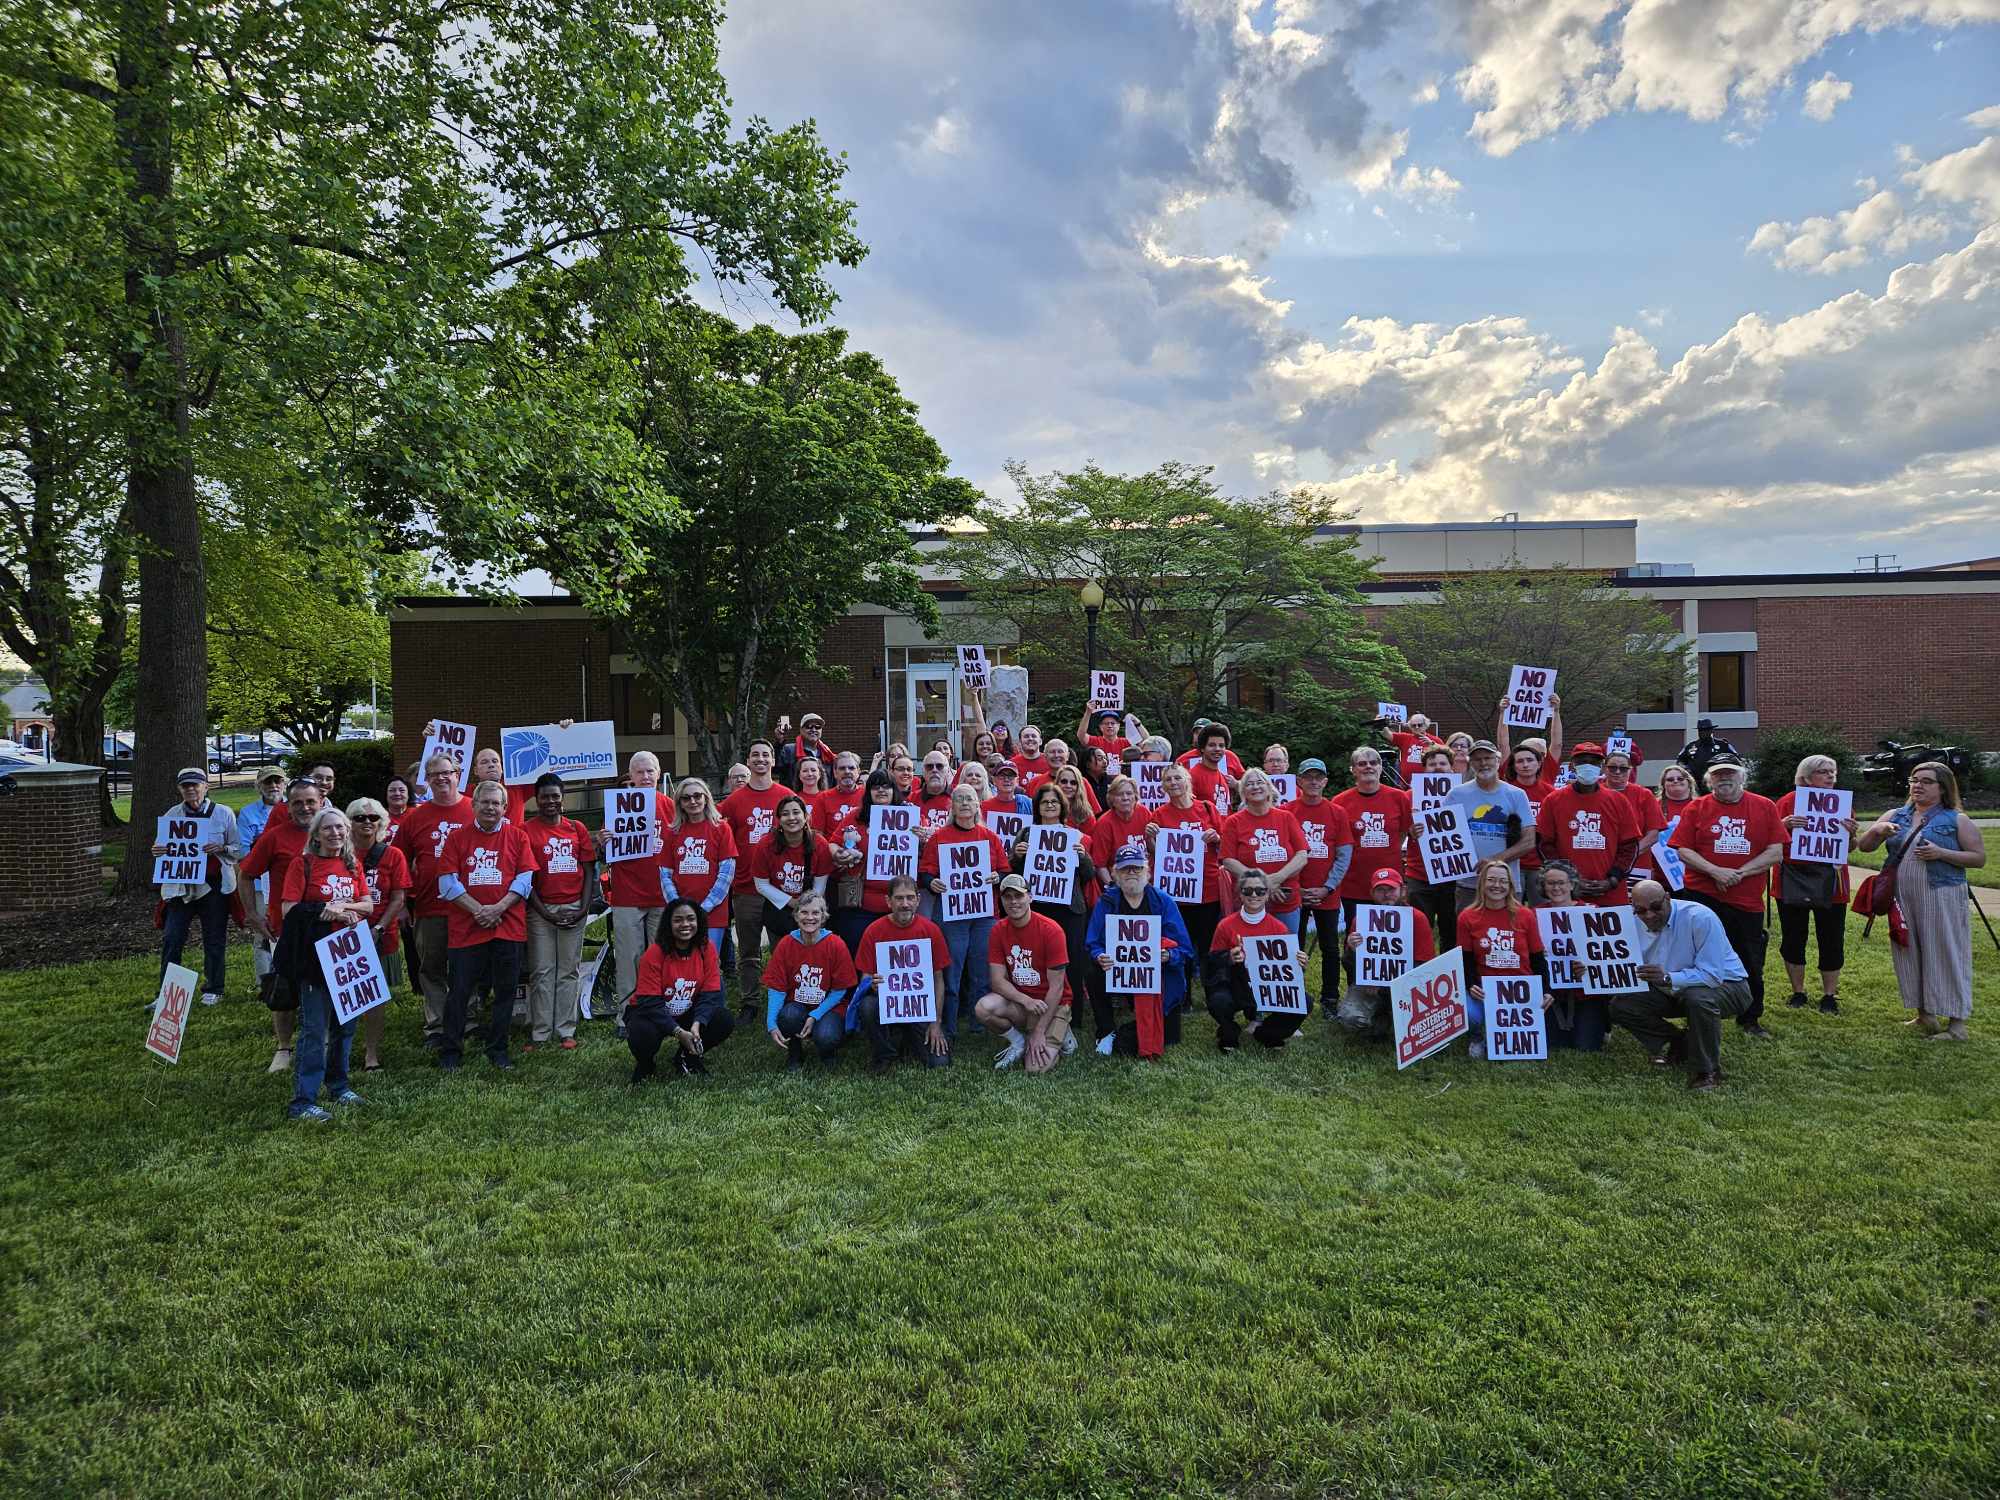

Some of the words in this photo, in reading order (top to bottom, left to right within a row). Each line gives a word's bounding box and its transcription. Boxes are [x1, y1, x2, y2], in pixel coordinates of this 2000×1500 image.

[963, 648, 979, 660] NO
[964, 663, 982, 673] GAS
[965, 675, 987, 687] PLANT
[1100, 673, 1117, 686] NO
[1520, 669, 1547, 688] NO
[1097, 688, 1118, 699] GAS
[1515, 689, 1543, 704] GAS
[1095, 700, 1120, 709] PLANT
[1386, 705, 1399, 713] NO
[1509, 705, 1544, 724] PLANT
[439, 724, 466, 746] NO
[1614, 740, 1625, 748] NO
[549, 752, 612, 766] Dominion
[1141, 765, 1162, 782] NO
[1140, 786, 1165, 799] GAS
[1424, 777, 1451, 796] NO
[616, 792, 645, 814] NO
[1422, 800, 1440, 811] GA
[1808, 792, 1839, 814] NO
[615, 817, 646, 833] GAS
[881, 809, 909, 830] NO
[996, 815, 1023, 836] NO
[1365, 819, 1385, 831] NO!
[1425, 813, 1456, 834] NO
[1578, 821, 1600, 833] NO!
[1803, 816, 1840, 834] GAS
[169, 820, 198, 839] NO
[1722, 825, 1746, 837] NO!
[166, 842, 198, 857] GAS
[612, 835, 649, 857] PLANT
[877, 834, 909, 851] GAS
[1039, 830, 1068, 852] NO
[1167, 832, 1195, 854] NO
[1260, 836, 1278, 847] NO!
[1429, 834, 1464, 854] GAS
[1798, 835, 1842, 859] PLANT
[552, 845, 573, 858] NO!
[687, 845, 707, 857] NO!
[950, 846, 979, 869] NO
[160, 860, 200, 879] PLANT
[476, 856, 498, 869] NO!
[873, 854, 912, 876] PLANT
[1034, 854, 1066, 873] GAS
[1163, 856, 1195, 874] GAS
[1430, 853, 1474, 879] PLANT
[949, 871, 982, 890] GAS
[1030, 874, 1068, 899] PLANT
[1160, 876, 1197, 898] PLANT
[332, 884, 354, 899] NO!
[948, 891, 988, 916] PLANT
[1119, 919, 1149, 941] NO
[1370, 909, 1401, 932] NO
[1551, 911, 1572, 934] N
[1583, 911, 1622, 937] NO
[327, 930, 361, 964] NO
[1256, 939, 1288, 960] NO
[1367, 936, 1403, 955] GAS
[1492, 937, 1515, 951] NO!
[1551, 938, 1577, 957] GA
[1586, 940, 1630, 960] GAS
[889, 944, 921, 969] NO
[1115, 945, 1151, 963] GAS
[334, 956, 370, 987] GAS
[1112, 967, 1155, 988] PLANT
[1259, 965, 1294, 982] GAS
[1363, 957, 1407, 982] PLANT
[1588, 963, 1639, 989] PLANT
[802, 974, 822, 987] NO!
[887, 972, 924, 991] GAS
[338, 975, 382, 1016] PLANT
[673, 988, 696, 1000] NO!
[1259, 985, 1300, 1009] PLANT
[1411, 969, 1460, 1013] NO!
[1497, 980, 1530, 1004] NO
[163, 981, 190, 1023] NO!
[886, 994, 928, 1018] PLANT
[1398, 1000, 1411, 1013] SAY
[1410, 1005, 1454, 1037] CHESTERFIELD
[1496, 1008, 1534, 1027] GAS
[1494, 1031, 1539, 1055] PLANT
